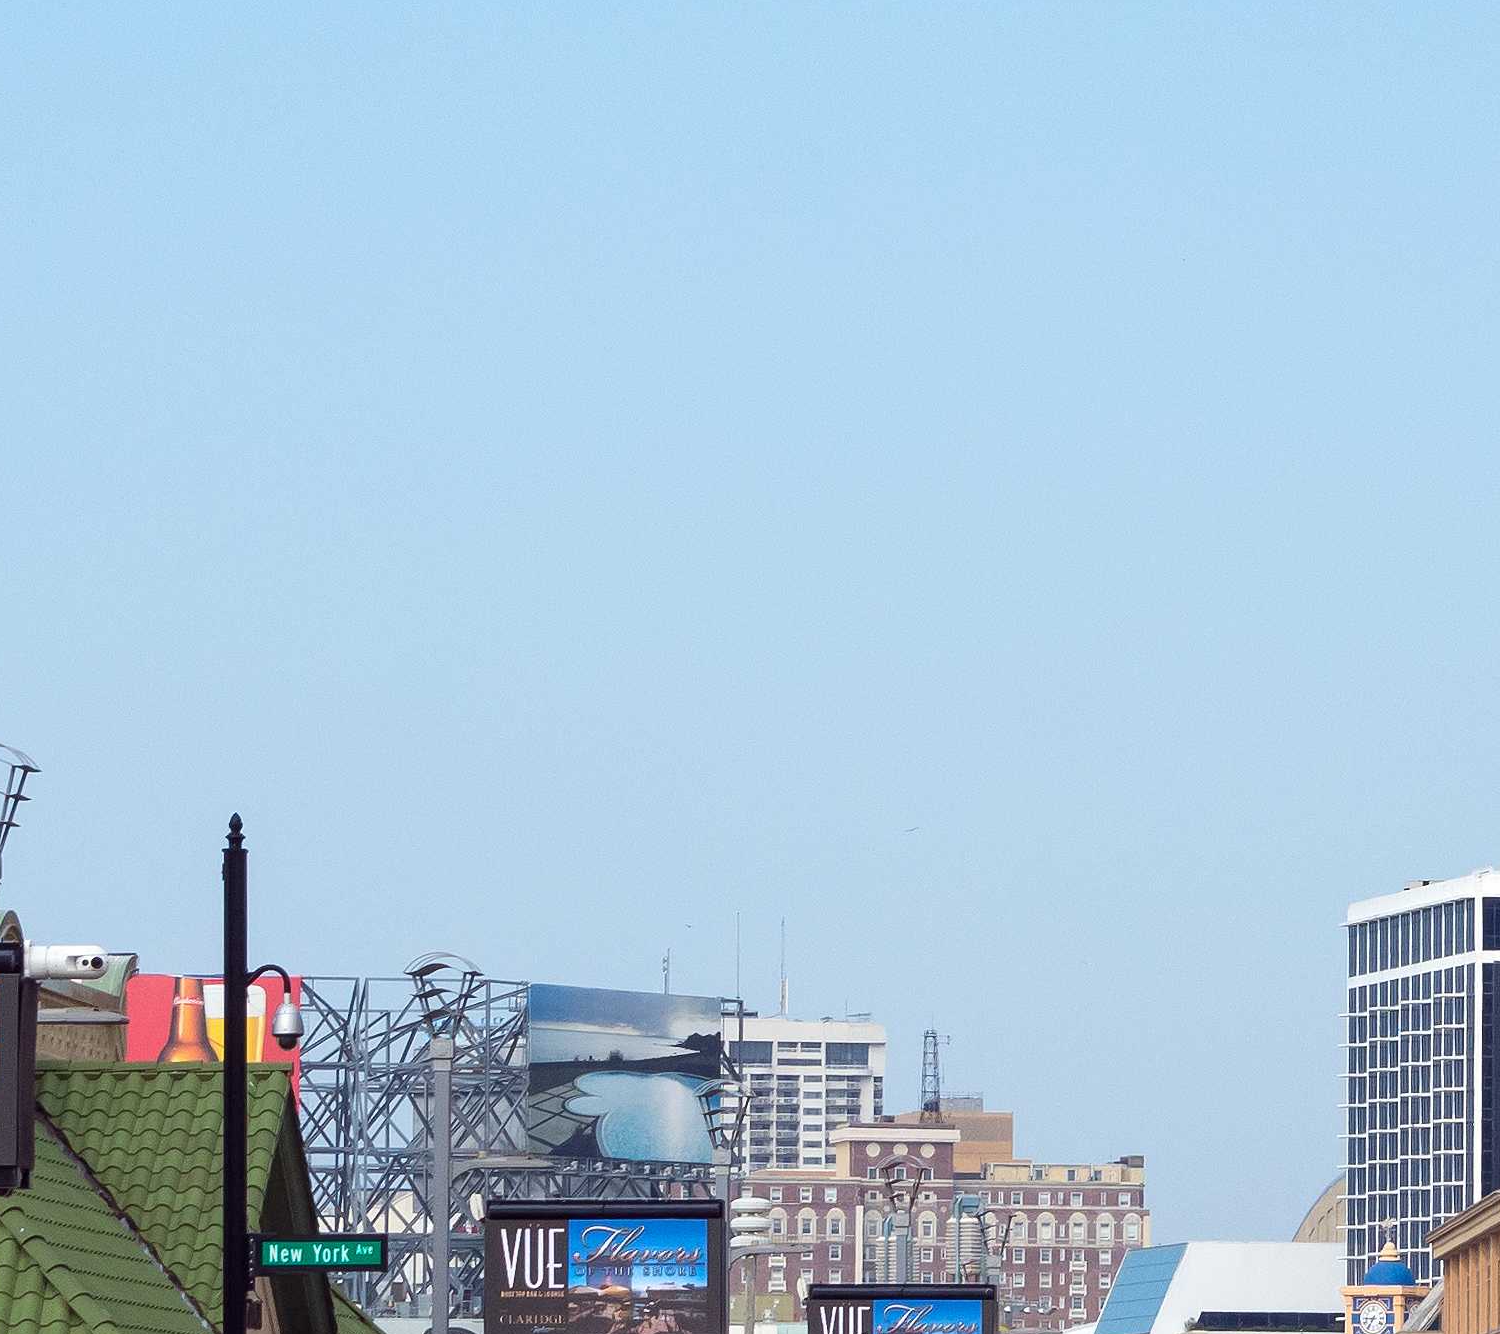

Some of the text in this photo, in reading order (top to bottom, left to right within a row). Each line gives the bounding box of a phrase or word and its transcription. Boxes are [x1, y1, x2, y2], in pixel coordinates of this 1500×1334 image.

[269, 1244, 374, 1264] New York Ave
[572, 1224, 702, 1264] Flavors
[876, 1304, 979, 1334] Flavors
